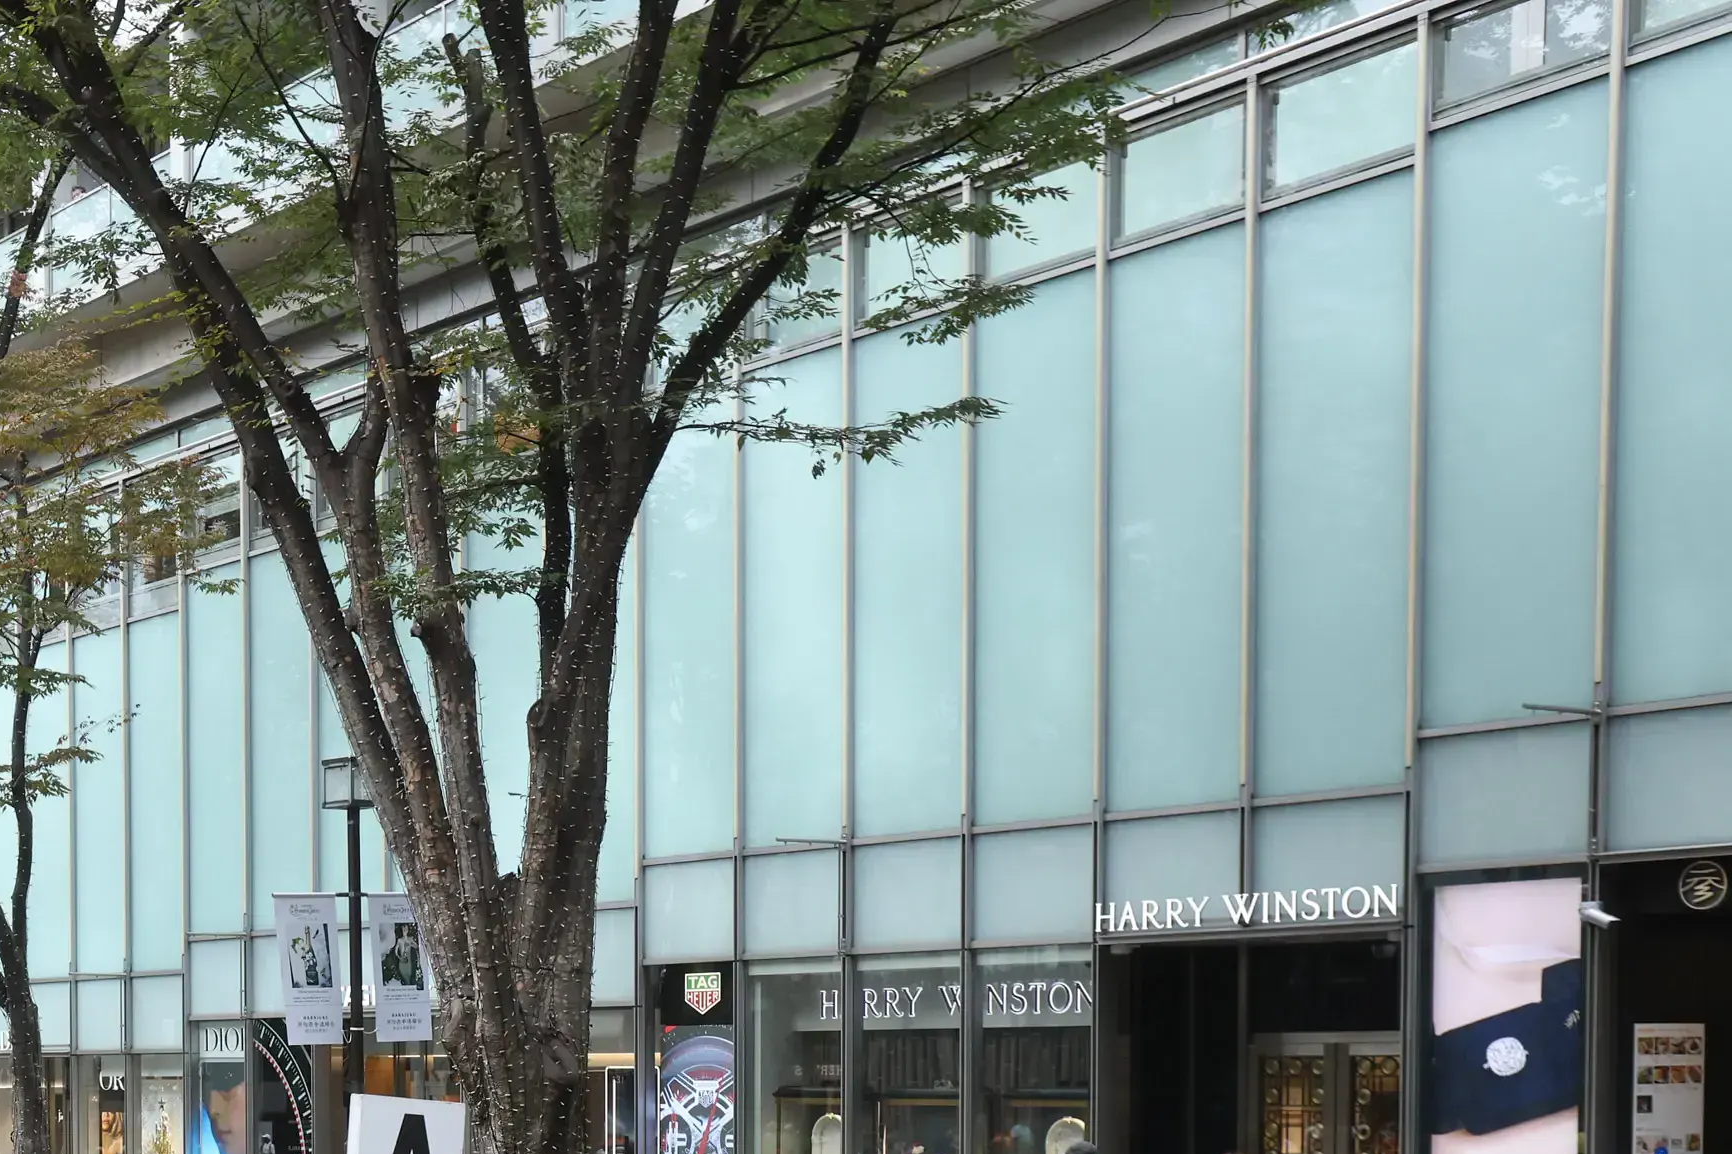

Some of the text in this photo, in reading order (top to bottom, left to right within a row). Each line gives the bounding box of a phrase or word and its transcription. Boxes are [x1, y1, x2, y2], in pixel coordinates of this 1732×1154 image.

[1094, 883, 1399, 933] HARRY WINSTON
[688, 975, 718, 989] TAG
[686, 991, 719, 1010] HEUER
[819, 980, 1093, 1020] HRRY WNSTON
